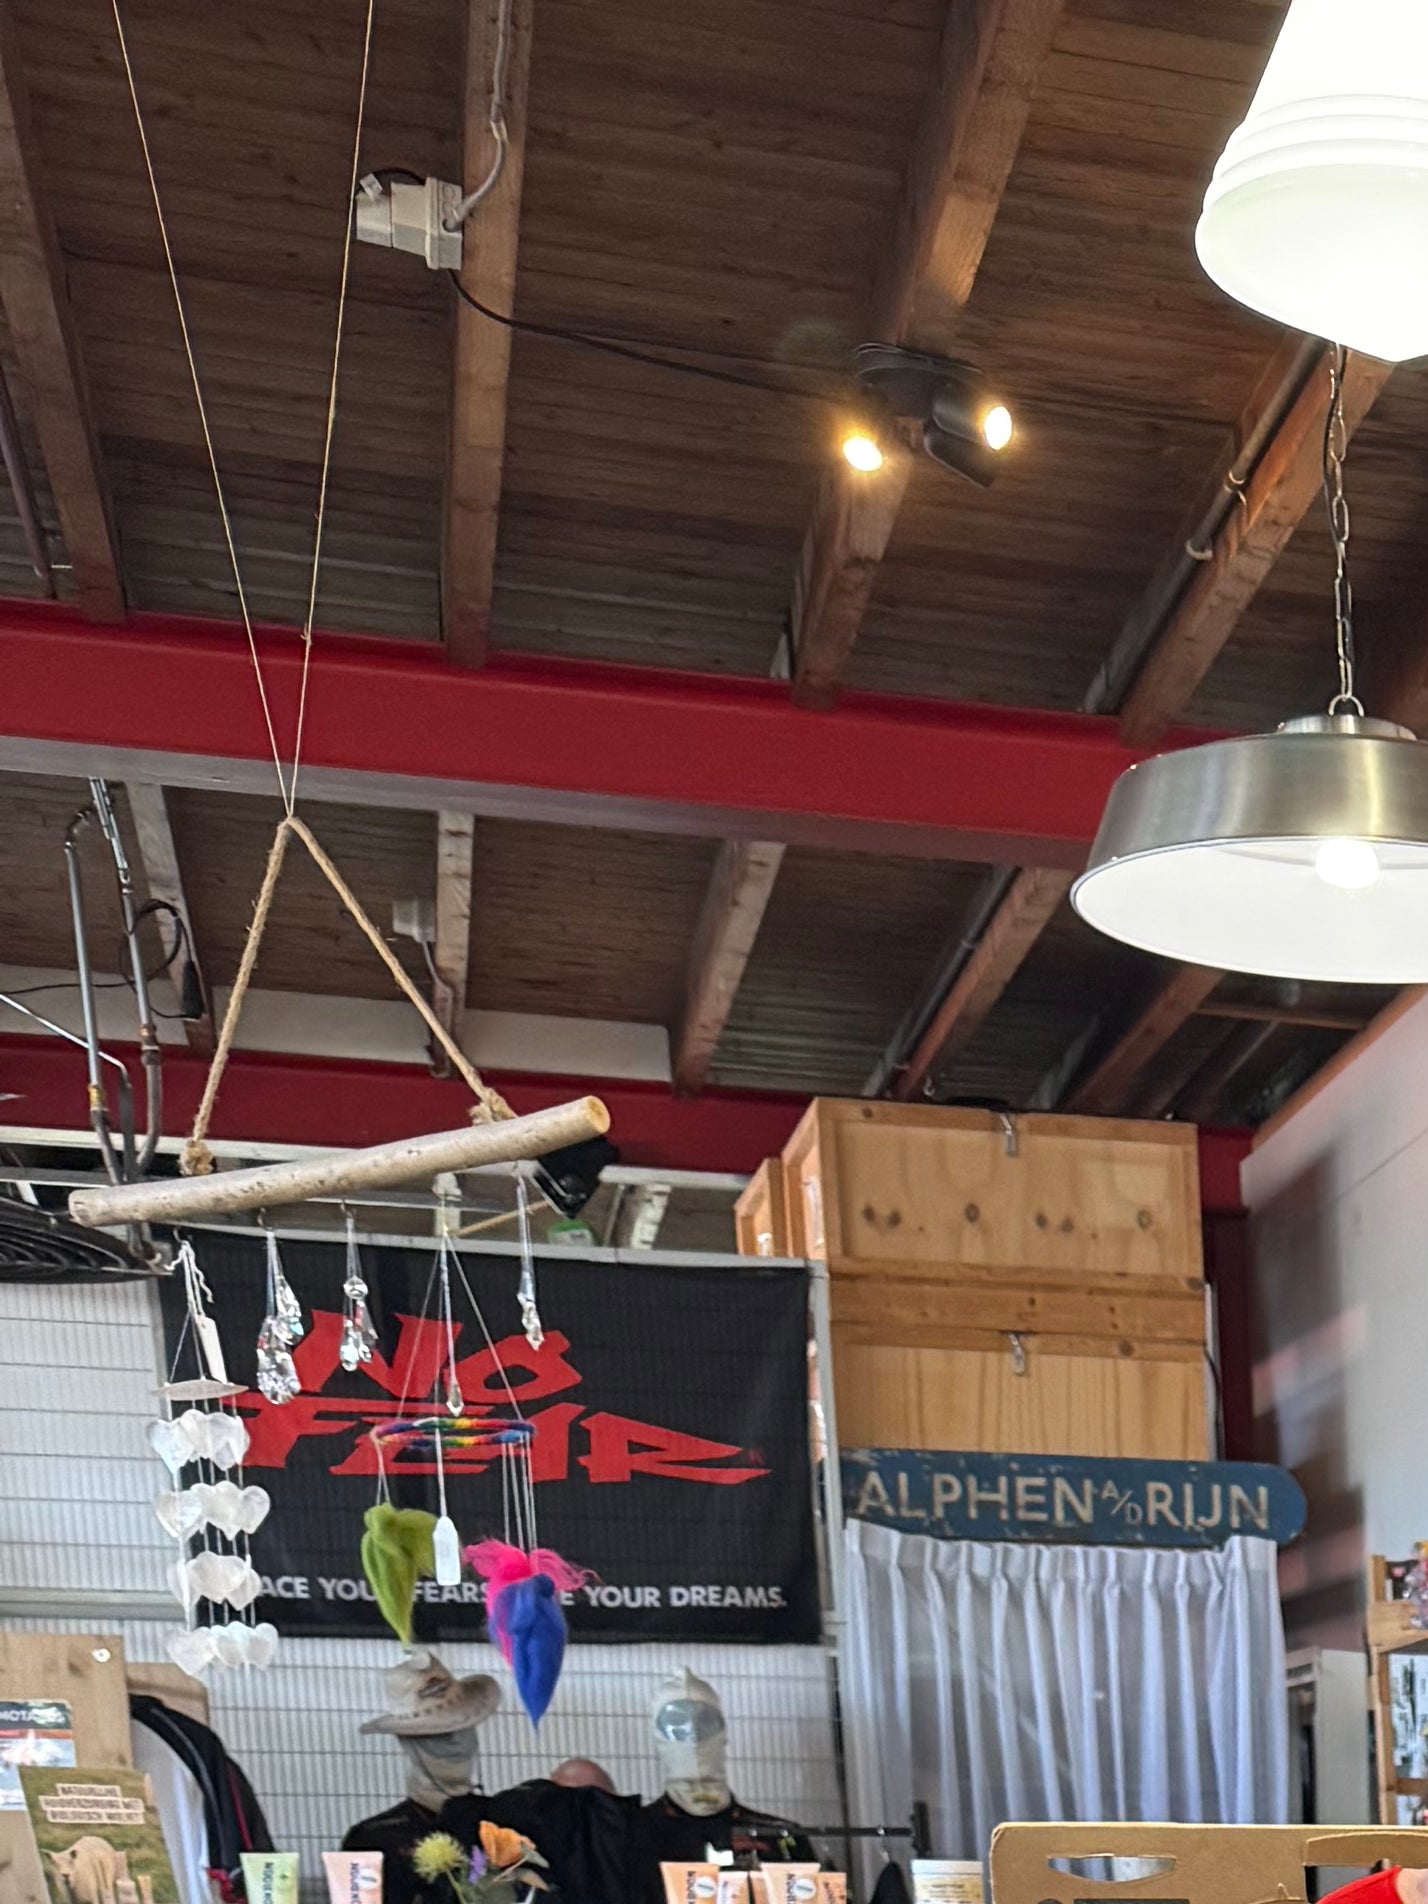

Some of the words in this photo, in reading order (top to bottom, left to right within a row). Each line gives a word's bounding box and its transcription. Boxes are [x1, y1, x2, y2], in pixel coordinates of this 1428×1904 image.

[857, 1471, 1094, 1526] ALPHEN
[1145, 1481, 1269, 1531] RIJN
[259, 1576, 309, 1598] ACE
[588, 1586, 661, 1608] YOUR
[669, 1586, 787, 1610] DREAMS.
